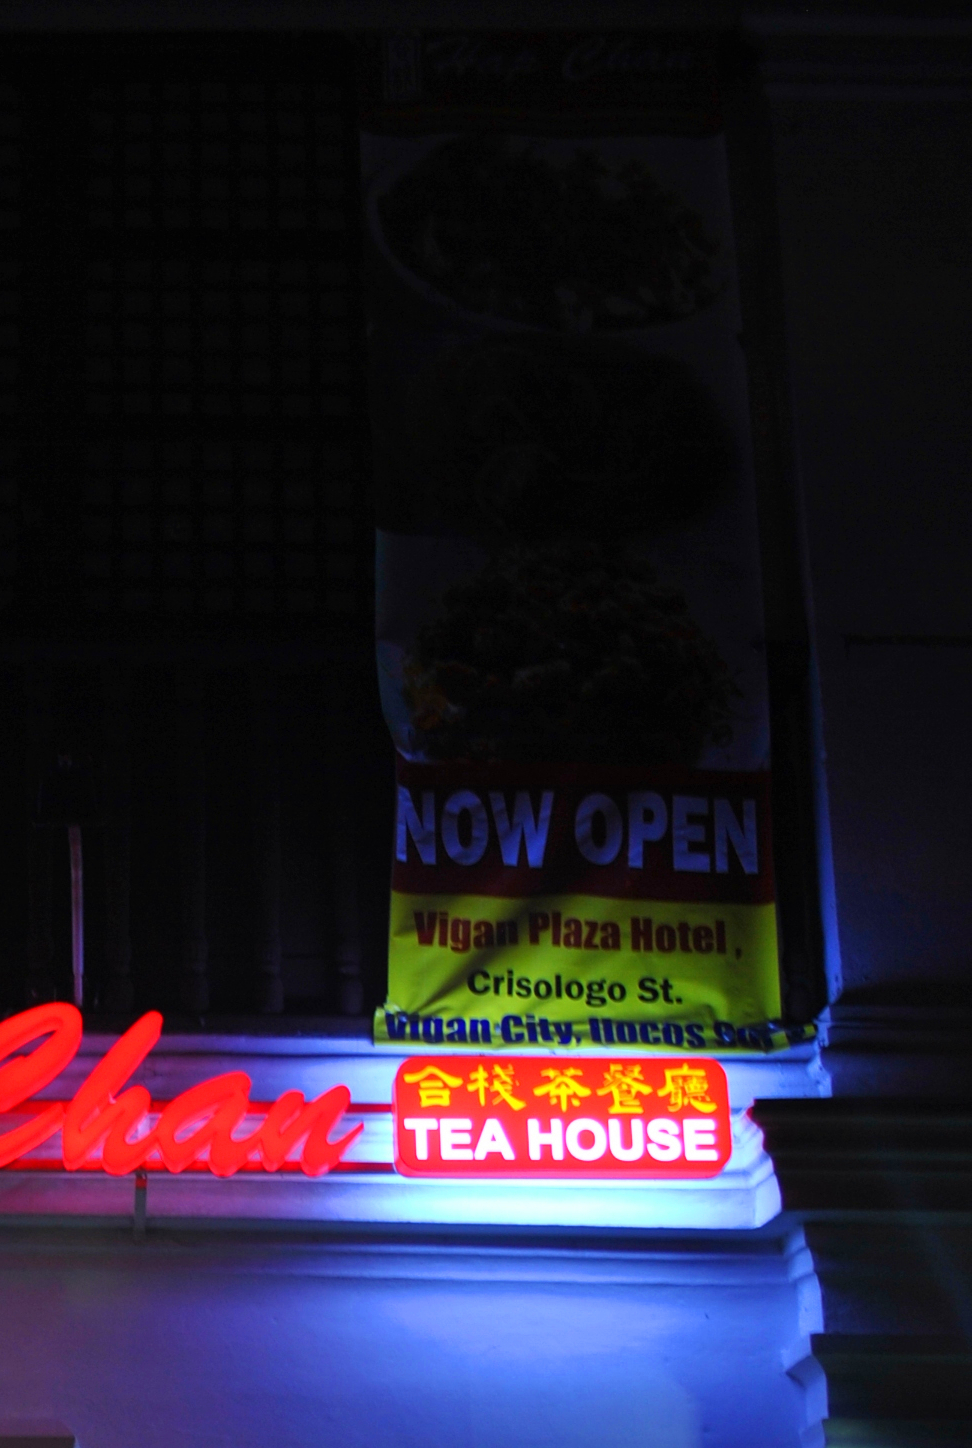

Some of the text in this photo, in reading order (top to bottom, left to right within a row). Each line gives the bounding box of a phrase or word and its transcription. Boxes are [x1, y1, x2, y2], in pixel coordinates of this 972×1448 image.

[396, 785, 759, 875] NOW OPEN
[413, 910, 519, 954] Vigan
[528, 911, 622, 952] Plaza
[467, 970, 683, 1008] Crisologo St.
[404, 1118, 718, 1162] TEA HOUSE
